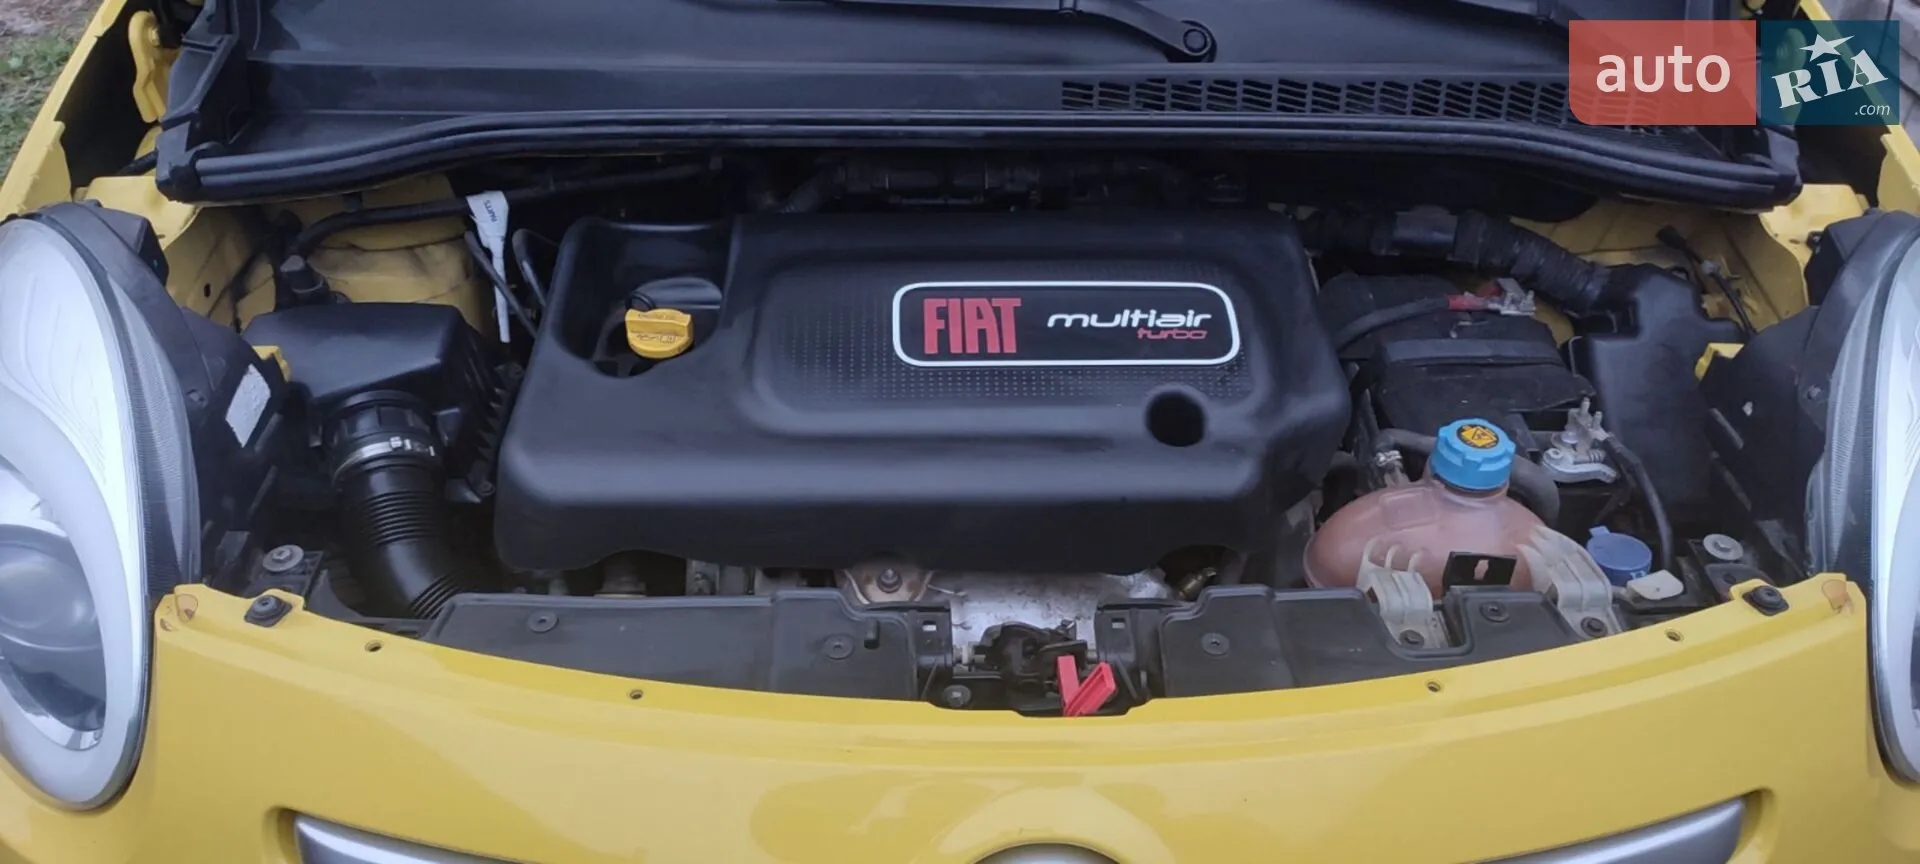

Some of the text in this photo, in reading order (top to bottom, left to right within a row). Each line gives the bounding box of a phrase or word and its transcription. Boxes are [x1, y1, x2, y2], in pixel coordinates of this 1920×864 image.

[923, 298, 1211, 354] FIAT multiair
[1136, 328, 1207, 339] turbo
